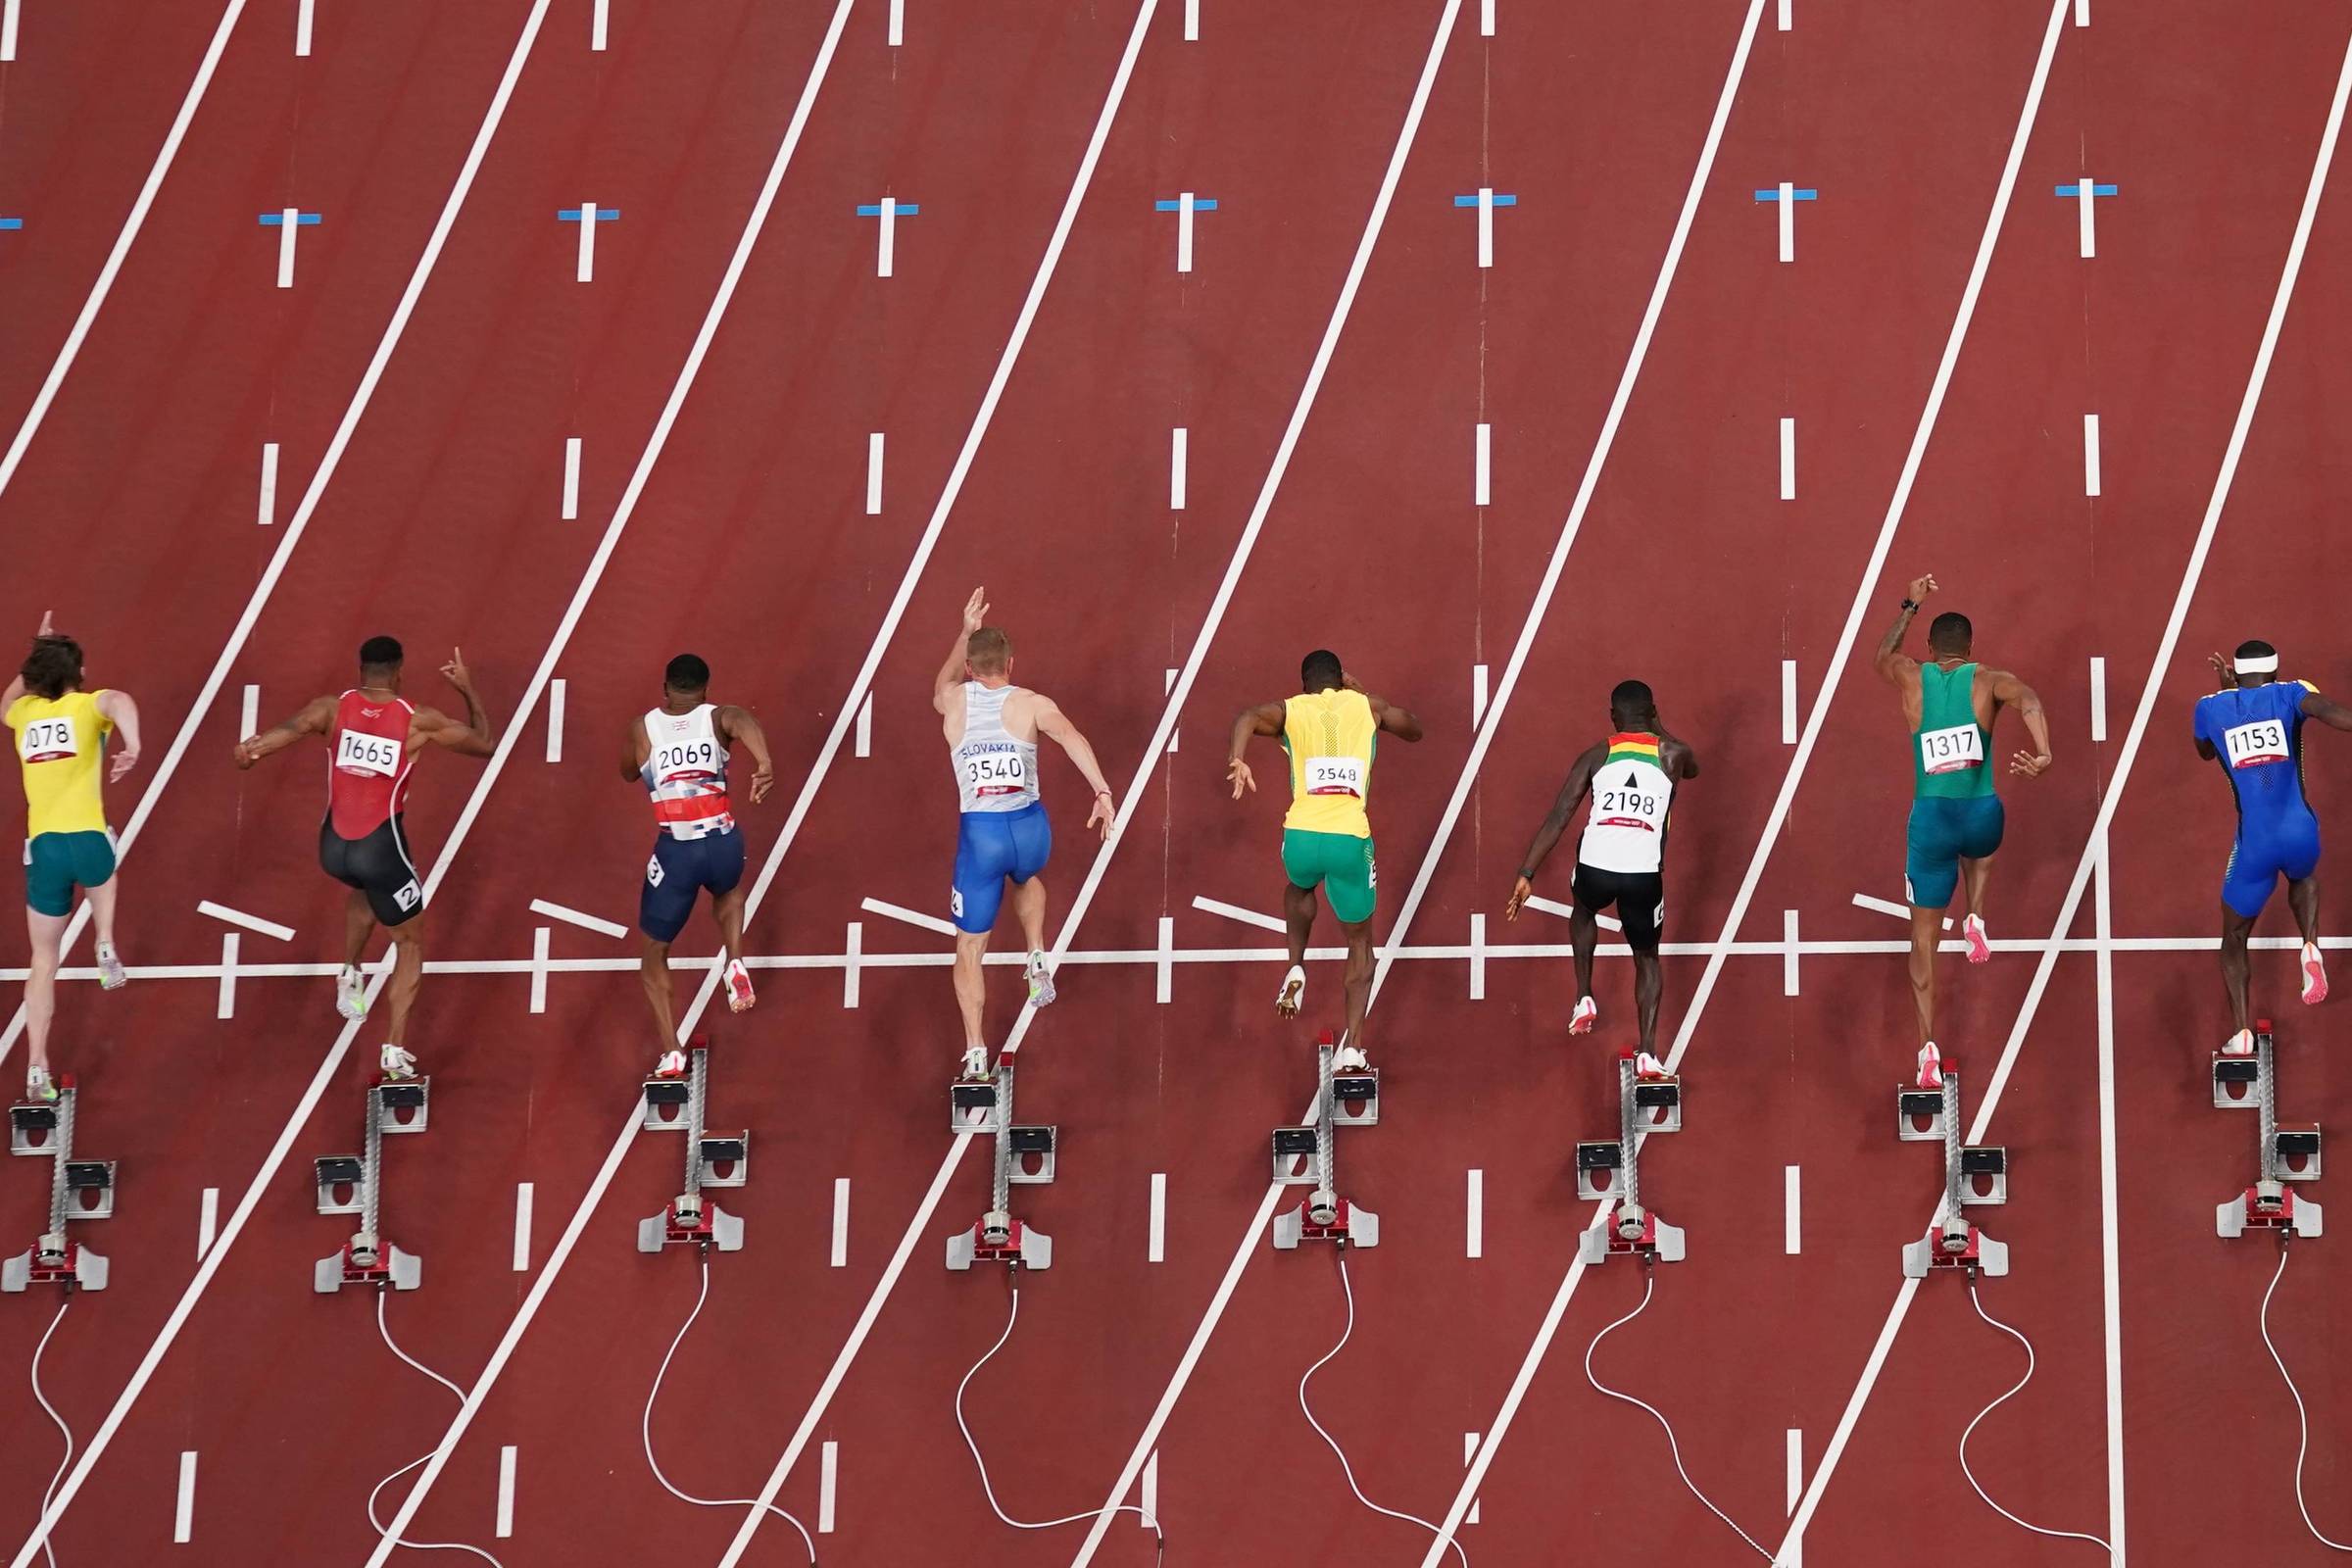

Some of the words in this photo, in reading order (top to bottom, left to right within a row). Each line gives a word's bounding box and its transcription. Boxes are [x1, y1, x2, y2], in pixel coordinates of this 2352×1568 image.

[345, 736, 393, 765] 1665
[1926, 730, 1973, 758] 1317
[2230, 726, 2279, 753] 1153
[659, 743, 711, 770] 2069
[959, 744, 1016, 760] SLOVAKIA
[968, 758, 1021, 782] 3540
[1316, 767, 1356, 781] 2548
[1602, 792, 1654, 815] 2198
[649, 861, 660, 880] 3
[402, 887, 417, 906] 2
